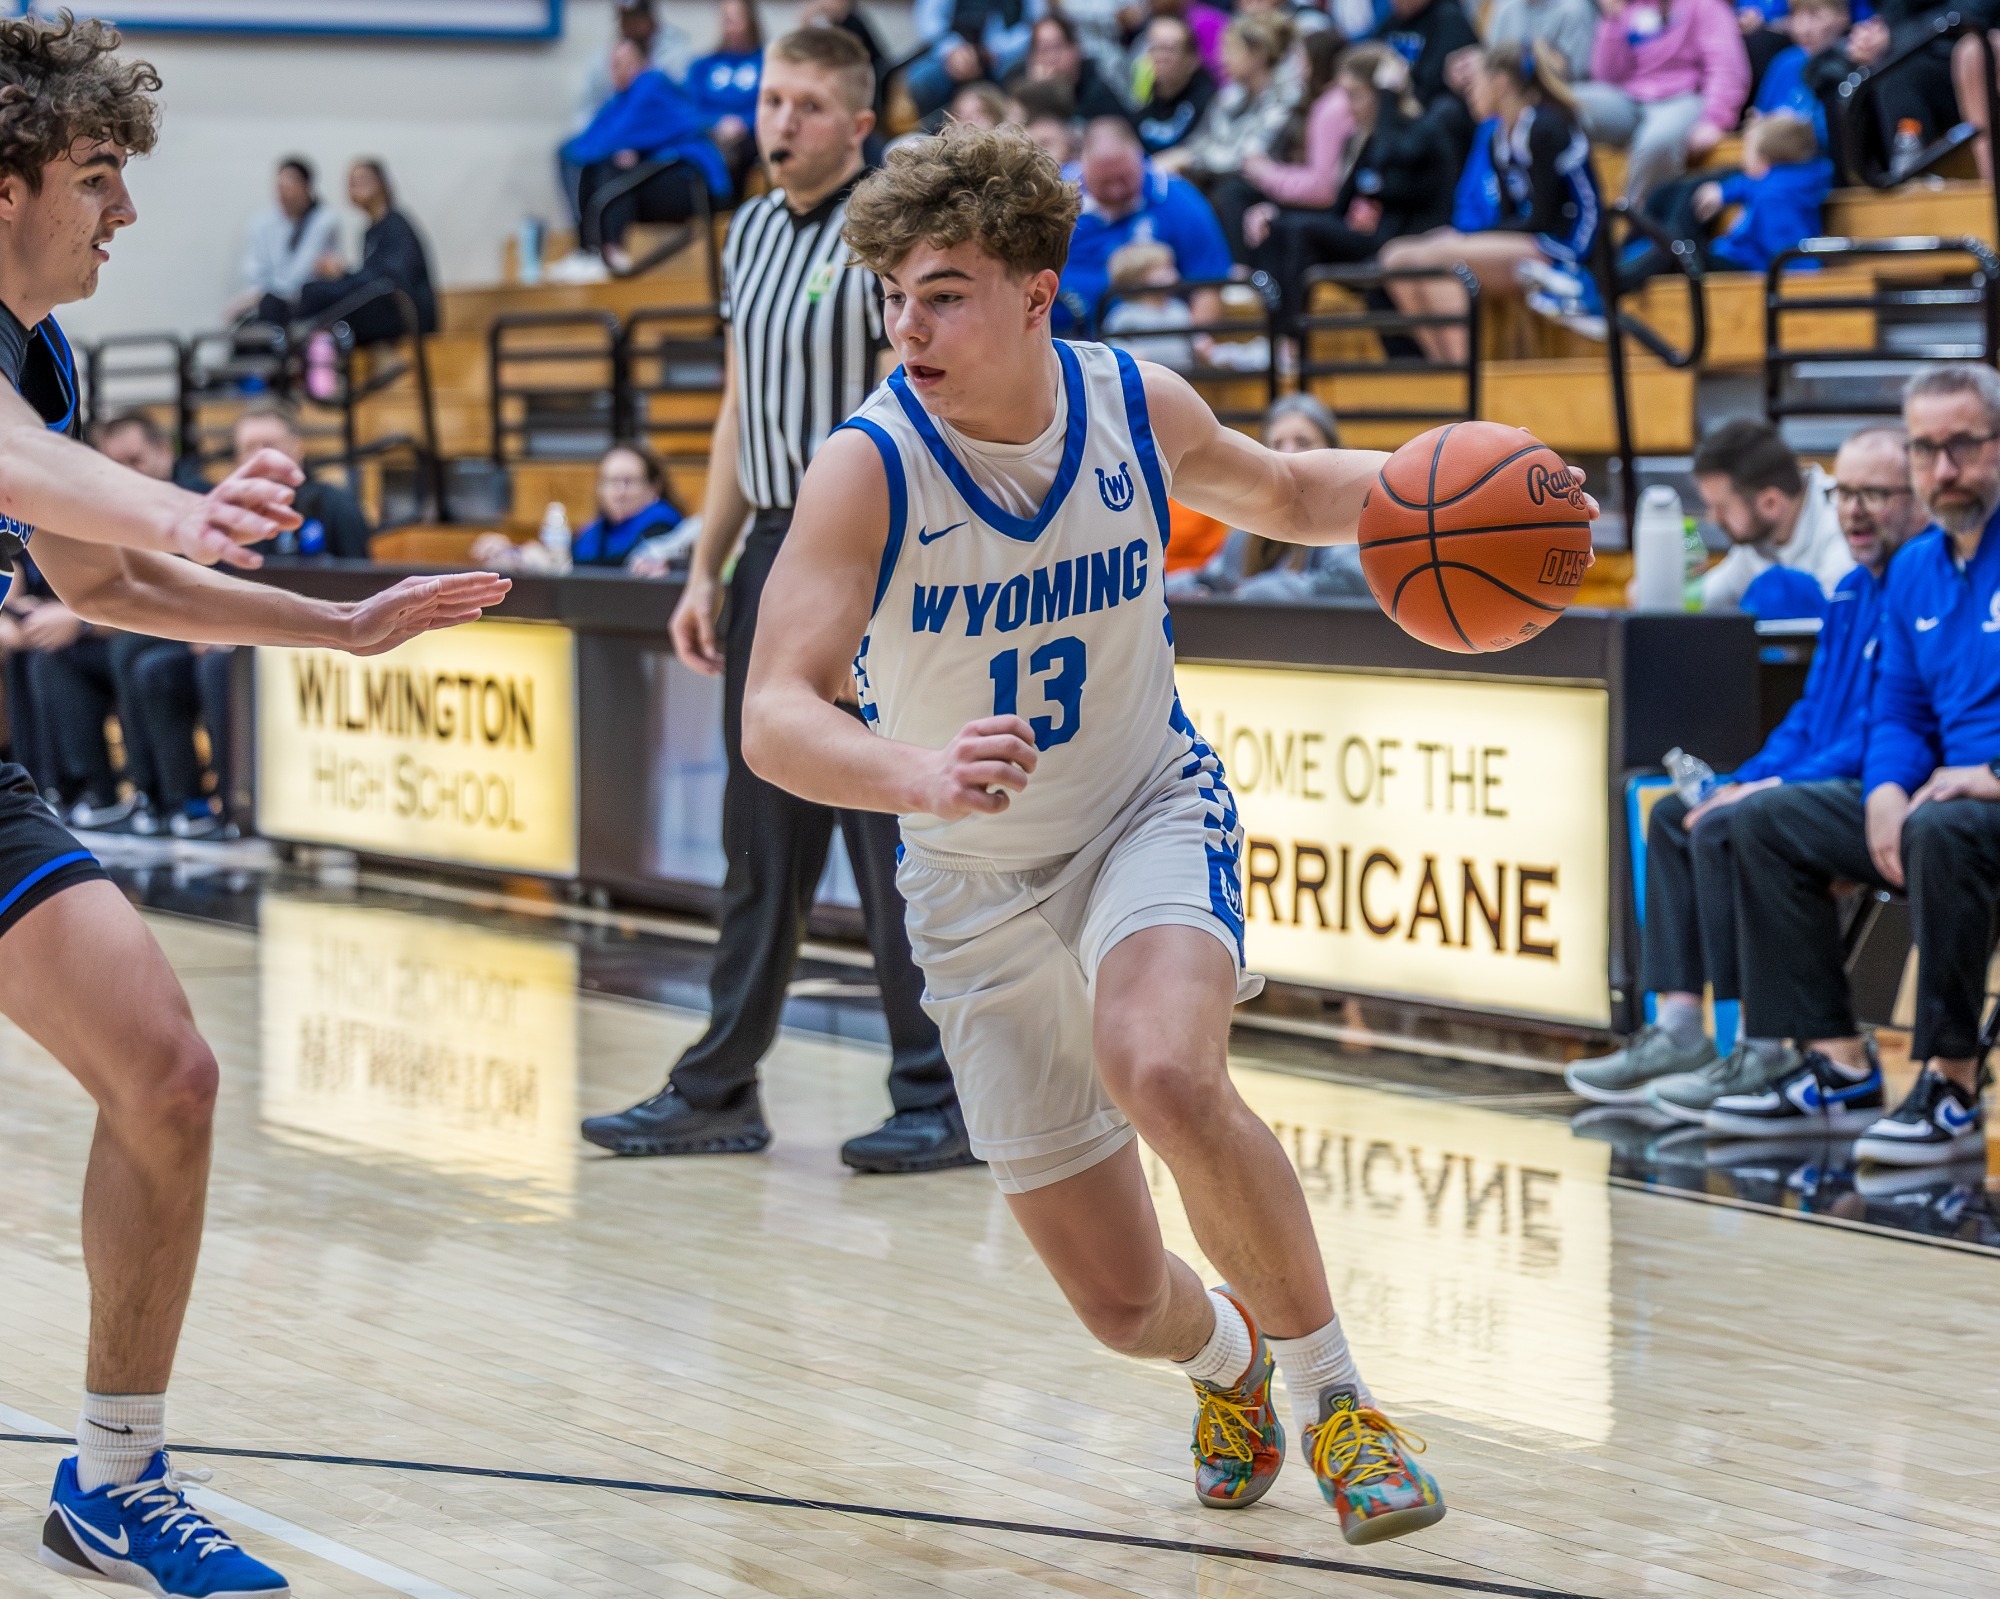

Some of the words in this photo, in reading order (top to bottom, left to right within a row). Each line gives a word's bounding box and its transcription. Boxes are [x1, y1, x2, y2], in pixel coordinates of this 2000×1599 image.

[912, 538, 1148, 637] WYOMING
[291, 652, 535, 751] WILMINGTON
[989, 635, 1087, 752] 13
[309, 745, 386, 813] HIGH
[393, 753, 526, 833] SCHOOL
[1338, 734, 1402, 806] OF
[1415, 740, 1509, 818] THE
[1246, 838, 1559, 965] RRICANE
